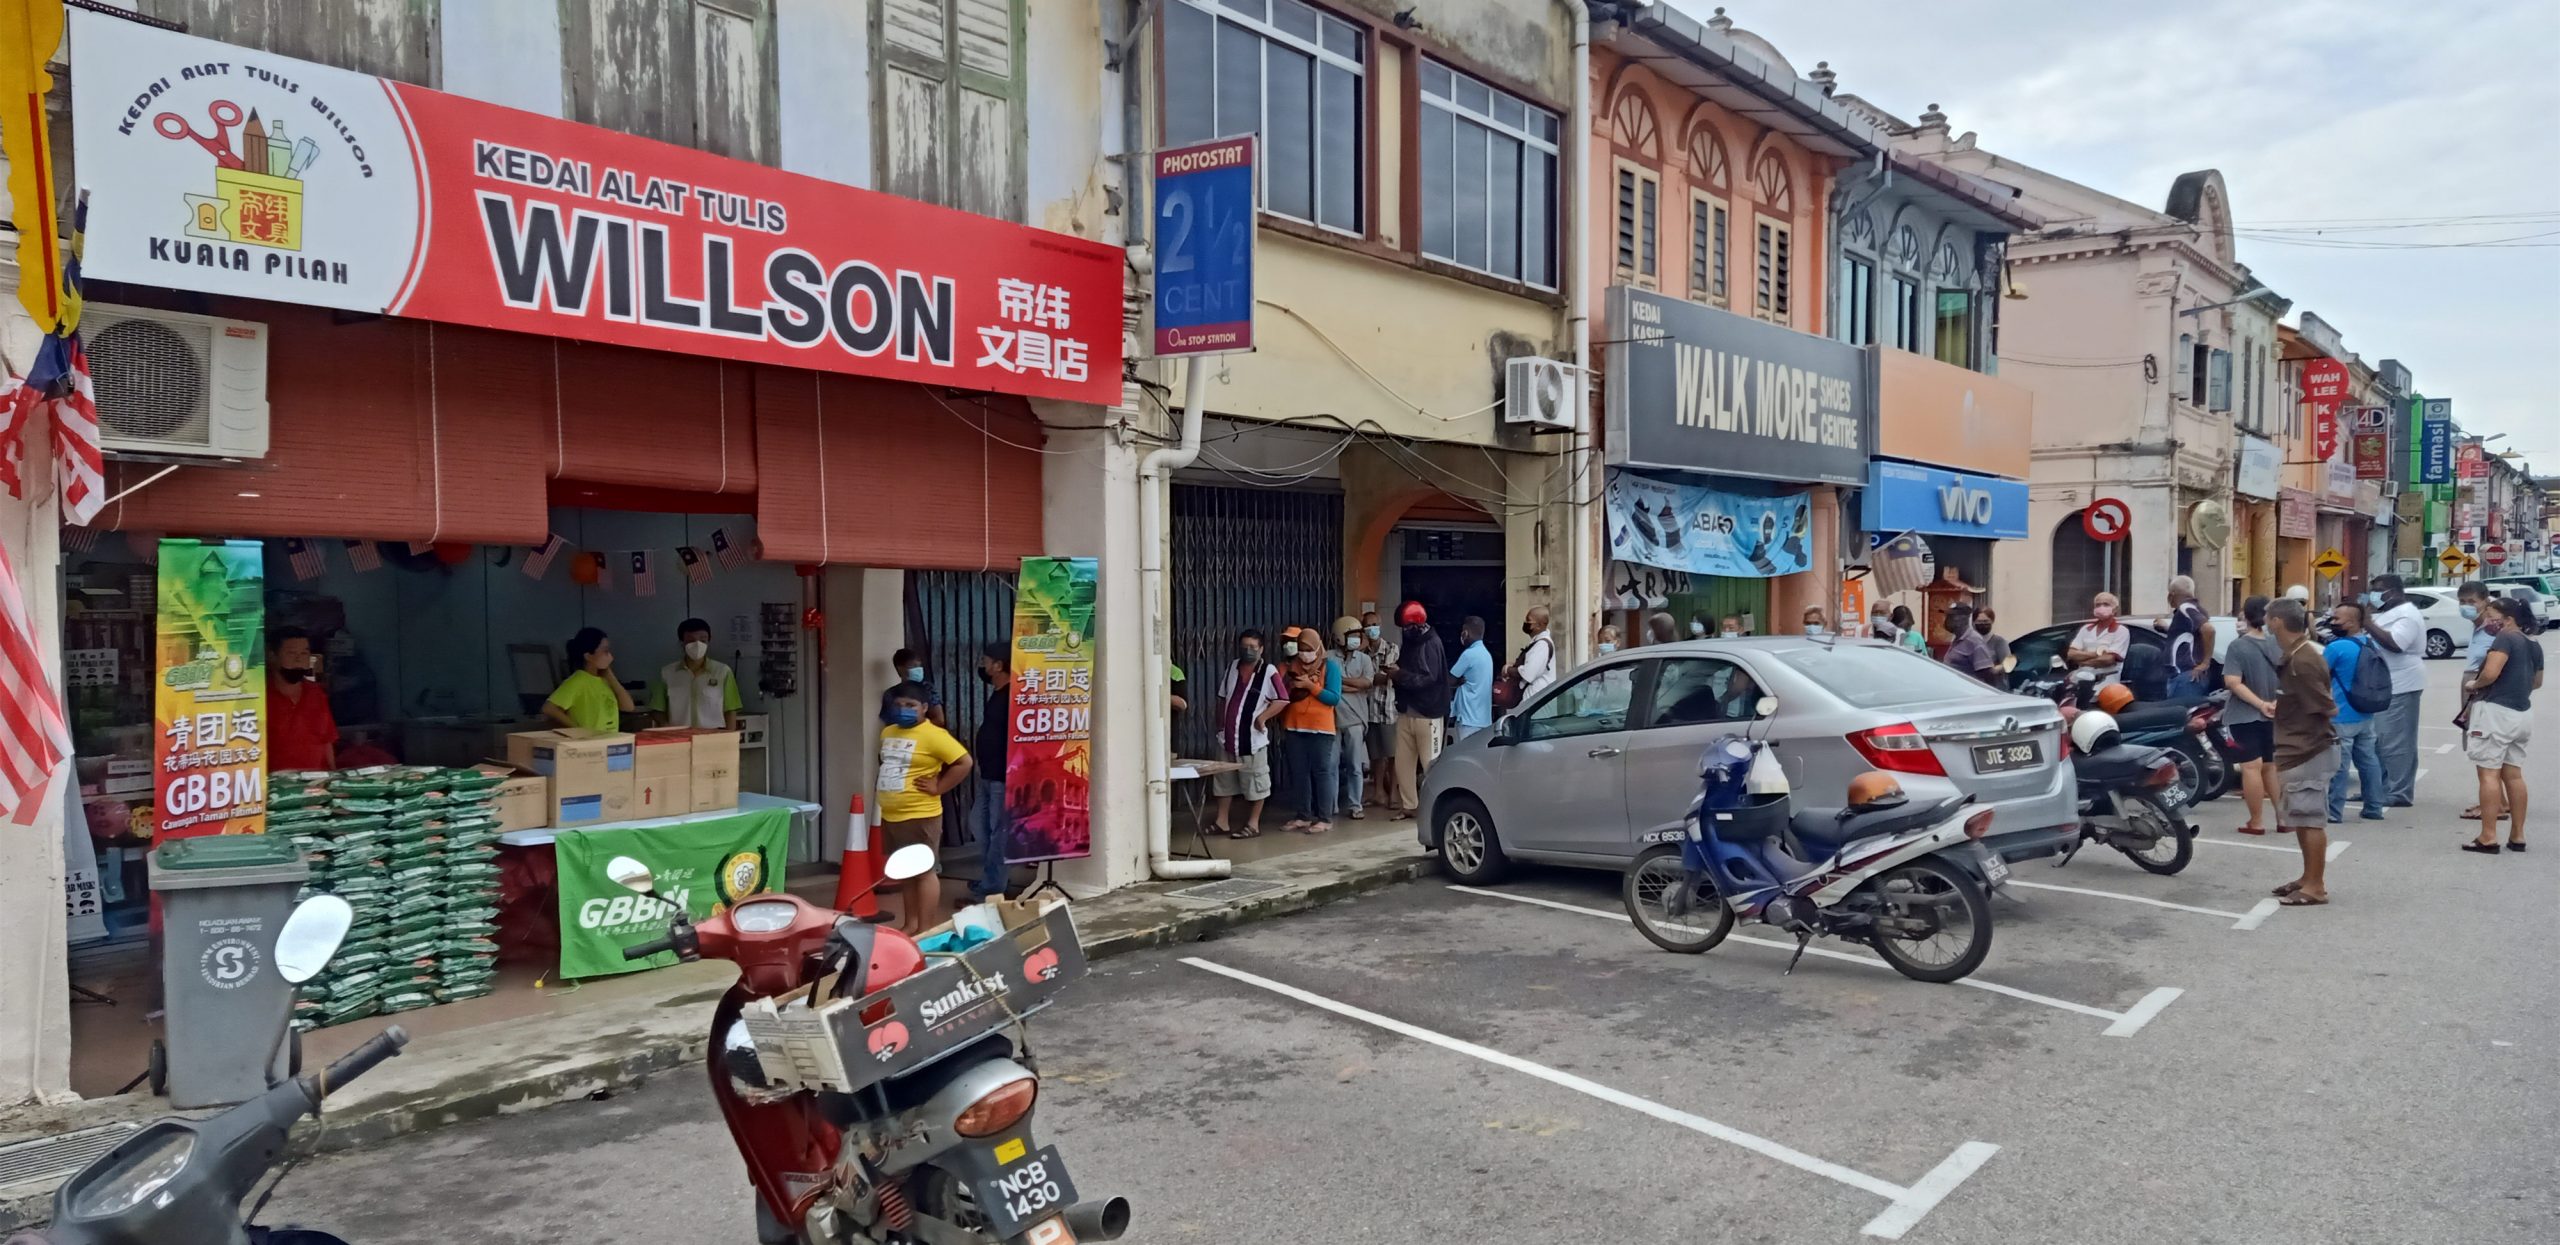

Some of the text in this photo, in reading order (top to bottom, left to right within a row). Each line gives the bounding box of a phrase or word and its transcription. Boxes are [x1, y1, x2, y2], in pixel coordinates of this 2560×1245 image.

[118, 63, 373, 178] KEDAI ALAT TULIS WILLSON
[1163, 146, 1243, 174] PHOTOSTAT
[475, 140, 787, 235] KEDAI ALAT TULIS
[1161, 189, 1195, 274] 2
[150, 237, 348, 284] KUALA PILAH
[476, 190, 955, 367] WILLSON
[998, 278, 1070, 330] 帝纬
[1165, 280, 1240, 314] CENT
[1632, 300, 1661, 324] KEDAI
[976, 325, 1088, 383] 文具店
[1188, 335, 1206, 346] STOP
[1207, 333, 1236, 344] STATION
[1632, 324, 1664, 348] KASUT
[1675, 342, 1818, 444] WALK MORE
[1820, 376, 1851, 413] SHOES
[2310, 373, 2340, 384] WAH
[2313, 386, 2338, 397] LEE
[1820, 414, 1857, 450] CENTRE
[2318, 404, 2330, 451] KEY
[2357, 409, 2385, 427] 4D
[2426, 423, 2445, 481] farmasi
[1017, 668, 1090, 692] 青团运
[166, 709, 262, 752] 青团运
[1017, 708, 1089, 734] GBBM
[1046, 733, 1067, 741] Taman
[1986, 745, 2033, 765] JTE 3329
[166, 768, 262, 815] GBBM
[199, 811, 228, 822] Taman
[231, 804, 262, 817] Fatimah
[1643, 831, 1686, 842] NCX 8538
[579, 885, 690, 929] GBBM
[920, 970, 1009, 1028] Sunkist
[997, 1161, 1048, 1200] NCB
[1005, 1180, 1061, 1222] 1430
